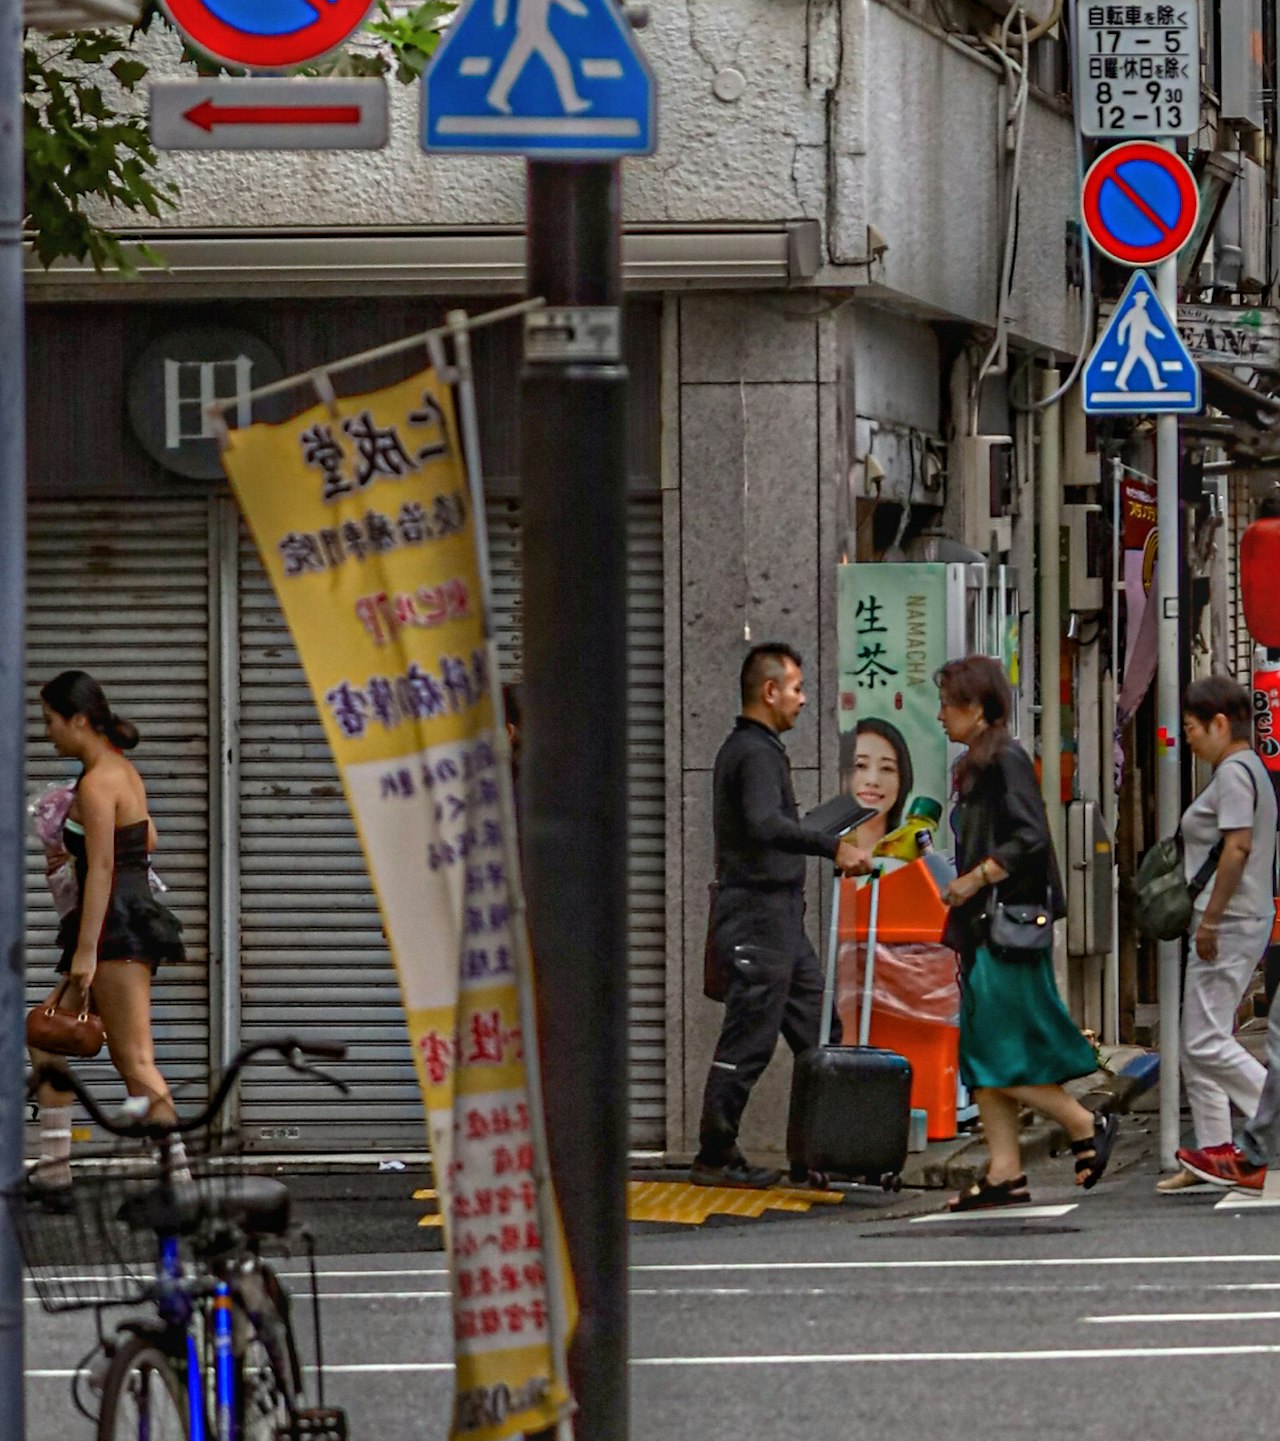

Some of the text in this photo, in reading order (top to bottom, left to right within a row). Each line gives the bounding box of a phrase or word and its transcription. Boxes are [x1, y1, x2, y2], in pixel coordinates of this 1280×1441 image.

[1088, 5, 1188, 26] 自転車を除く
[905, 594, 927, 686] NAMACHA
